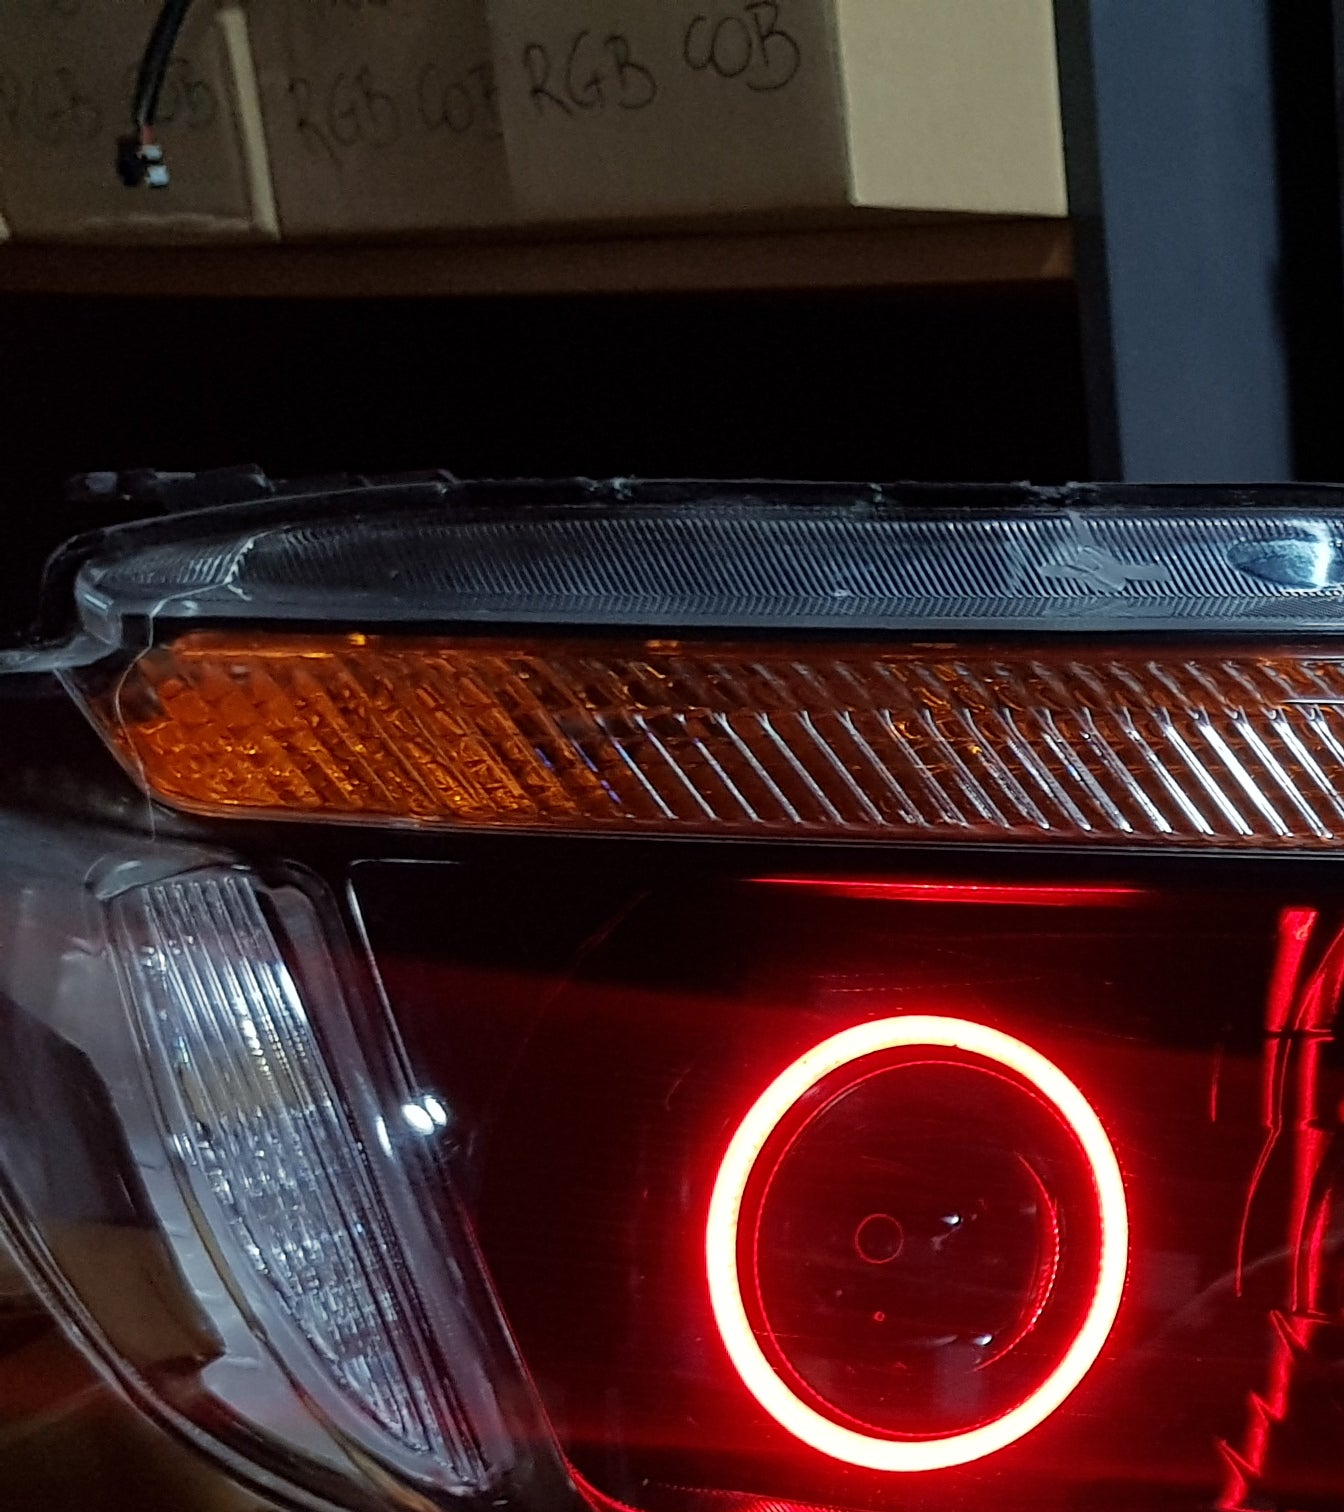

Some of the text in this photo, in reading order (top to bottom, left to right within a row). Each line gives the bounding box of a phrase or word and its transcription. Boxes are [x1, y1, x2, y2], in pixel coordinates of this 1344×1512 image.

[524, 0, 800, 117] RGB COB
[287, 64, 401, 170] RGB
